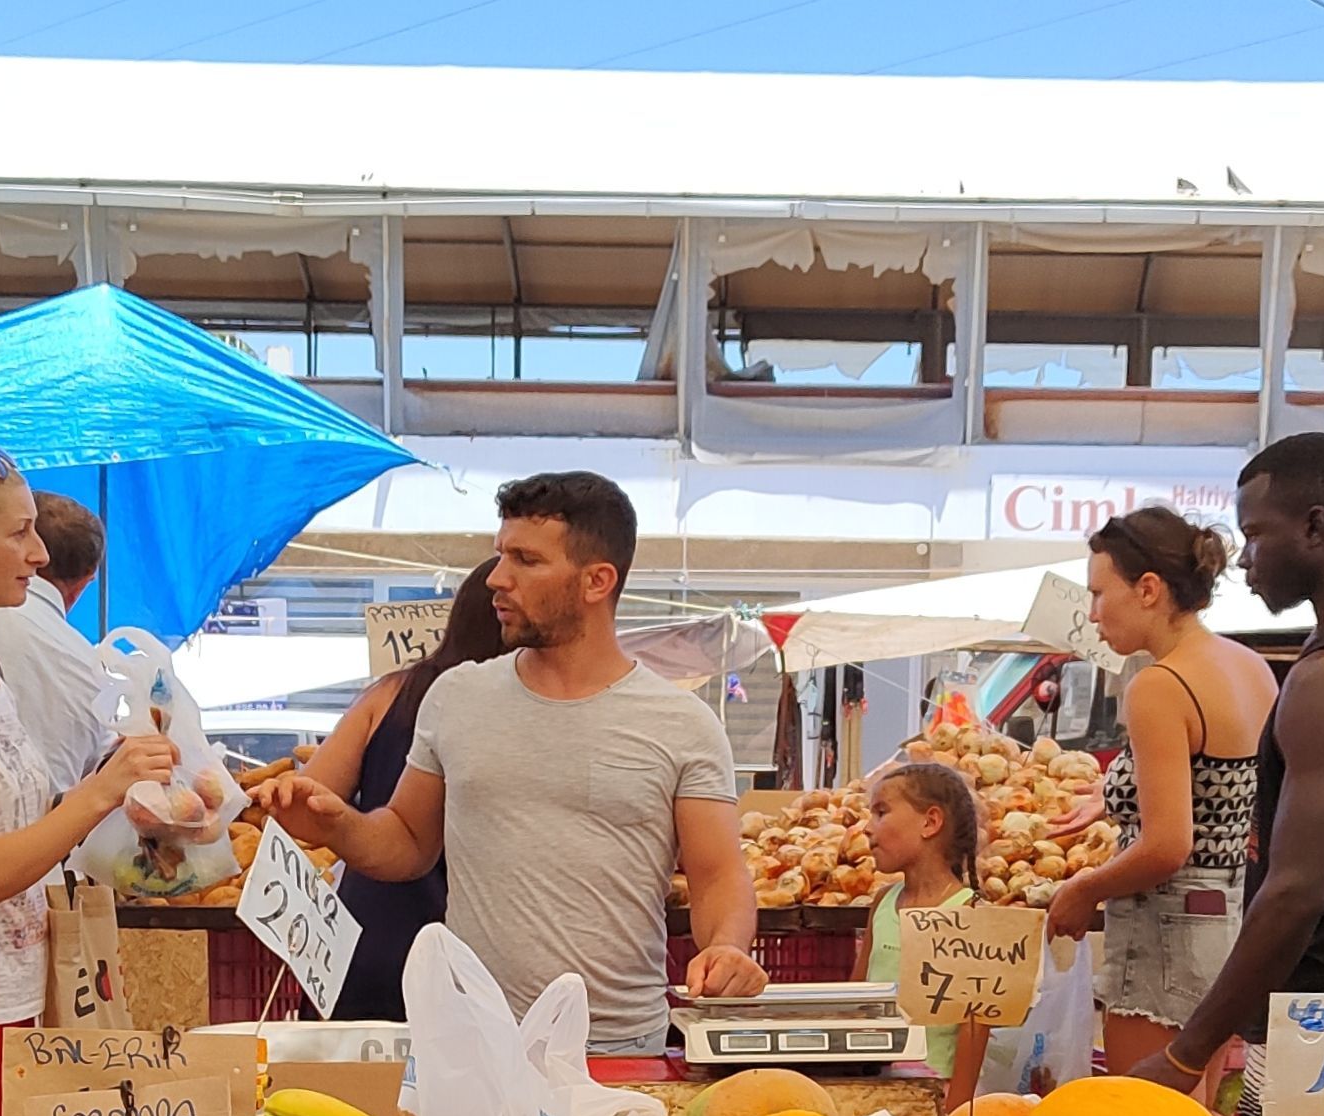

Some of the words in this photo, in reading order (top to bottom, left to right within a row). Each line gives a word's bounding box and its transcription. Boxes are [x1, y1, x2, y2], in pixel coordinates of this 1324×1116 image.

[1067, 610, 1086, 643] 8
[381, 627, 427, 665] 15
[906, 908, 971, 932] BAL
[932, 935, 1029, 965] KAVUN
[921, 961, 954, 1015] 7
[963, 1001, 1002, 1019] KG
